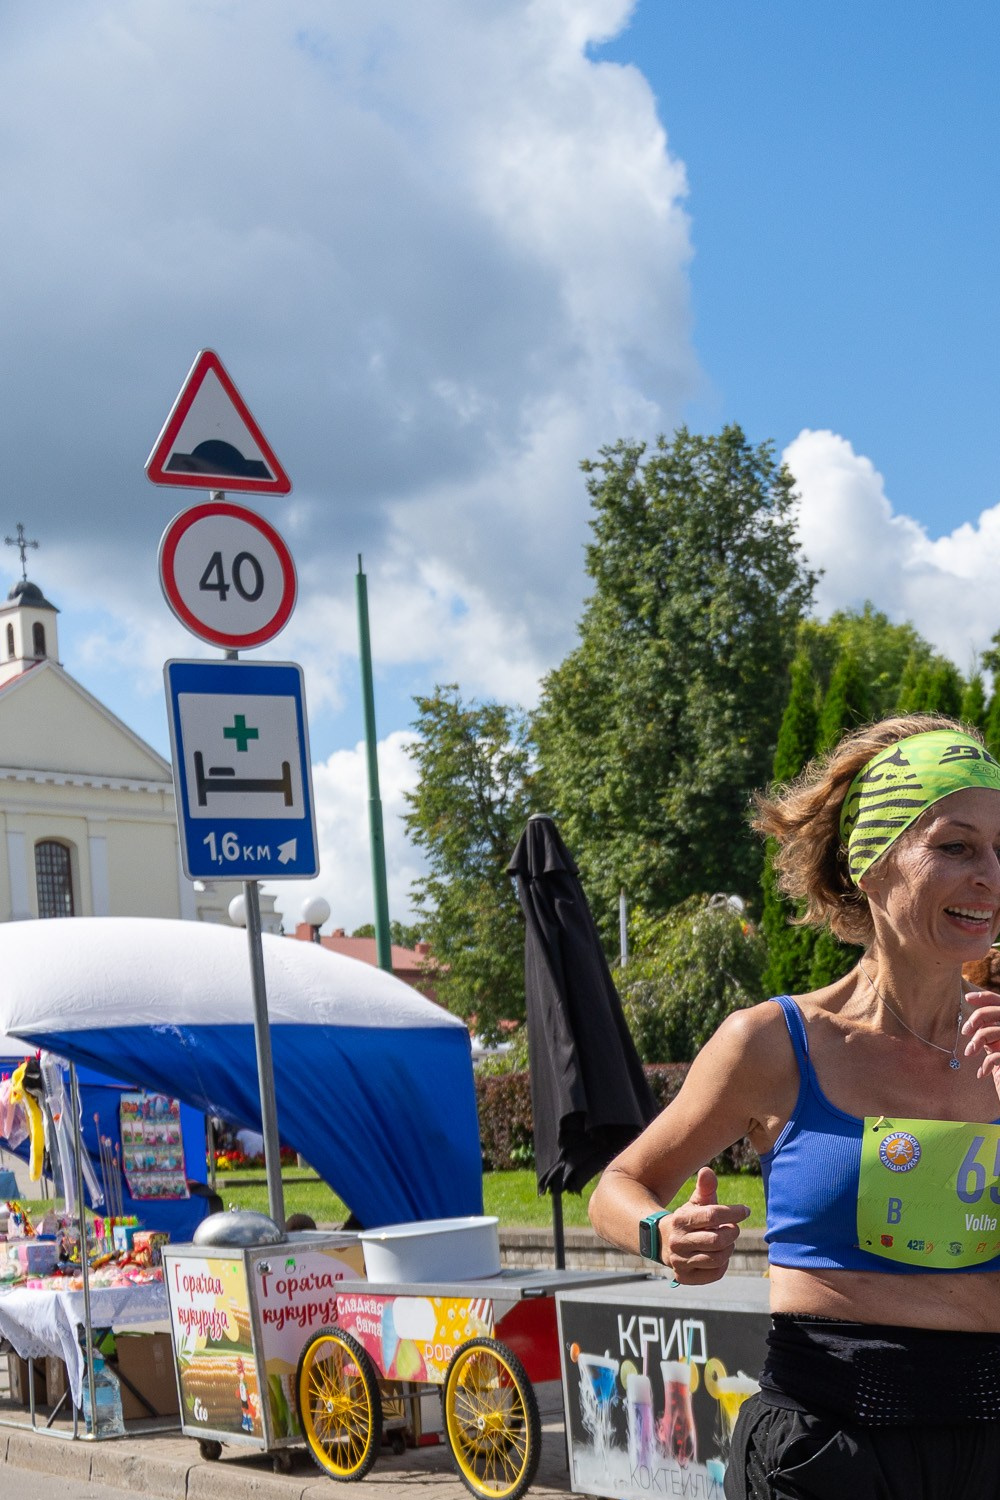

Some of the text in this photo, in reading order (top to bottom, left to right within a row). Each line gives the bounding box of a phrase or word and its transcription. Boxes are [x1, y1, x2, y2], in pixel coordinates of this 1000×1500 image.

[199, 551, 264, 602] 40
[203, 831, 240, 865] 1,6
[965, 1214, 998, 1231] Volha
[175, 1264, 224, 1301] Горячая
[178, 1306, 230, 1340] кукуруза
[262, 1298, 338, 1331] кукуруз
[618, 1314, 707, 1364] КРИО
[629, 1463, 719, 1500] КОКТЕЙЛИ
